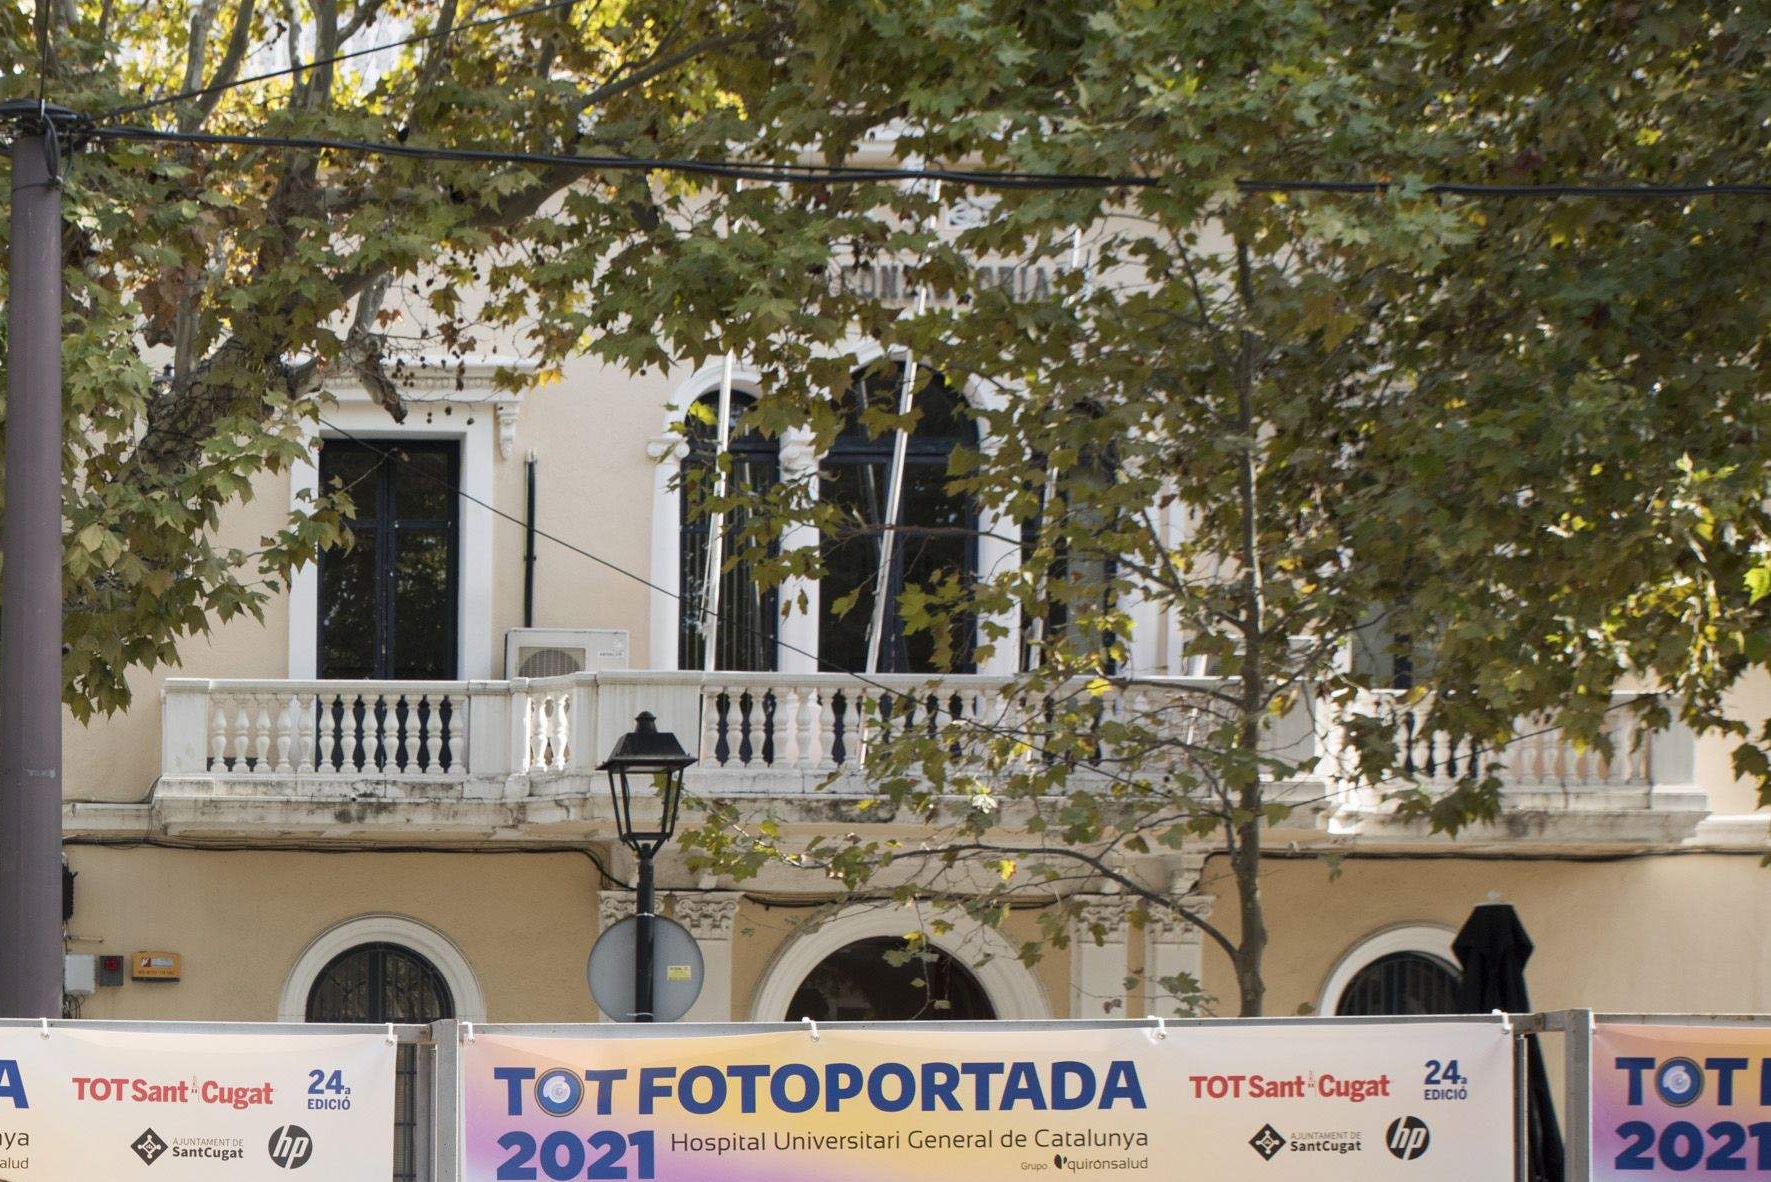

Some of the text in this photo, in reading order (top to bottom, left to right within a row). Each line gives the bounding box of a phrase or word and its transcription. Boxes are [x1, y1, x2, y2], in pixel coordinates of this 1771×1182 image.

[72, 1077, 130, 1102] TOT
[201, 1079, 274, 1111] Cugat
[638, 1061, 1148, 1116] FOTOPORTADA
[1189, 1075, 1246, 1099] TOT
[1318, 1073, 1390, 1103] Cugat
[1424, 1086, 1468, 1101] EDICIÓ
[307, 1096, 350, 1111] EDICIÓ
[172, 1137, 244, 1148] AJUNTAMENT DE
[270, 1124, 311, 1170] hp
[671, 1128, 1148, 1156] Hospital Universitari General de Catalunya
[1290, 1131, 1362, 1142] AJUNTAMENT DE
[1290, 1140, 1362, 1156] SantCugat
[1388, 1116, 1428, 1161] hp
[1614, 1120, 1771, 1171] 2021
[172, 1147, 244, 1162] SantCugat
[496, 1129, 655, 1182] 2021
[1020, 1161, 1048, 1174] Grupo
